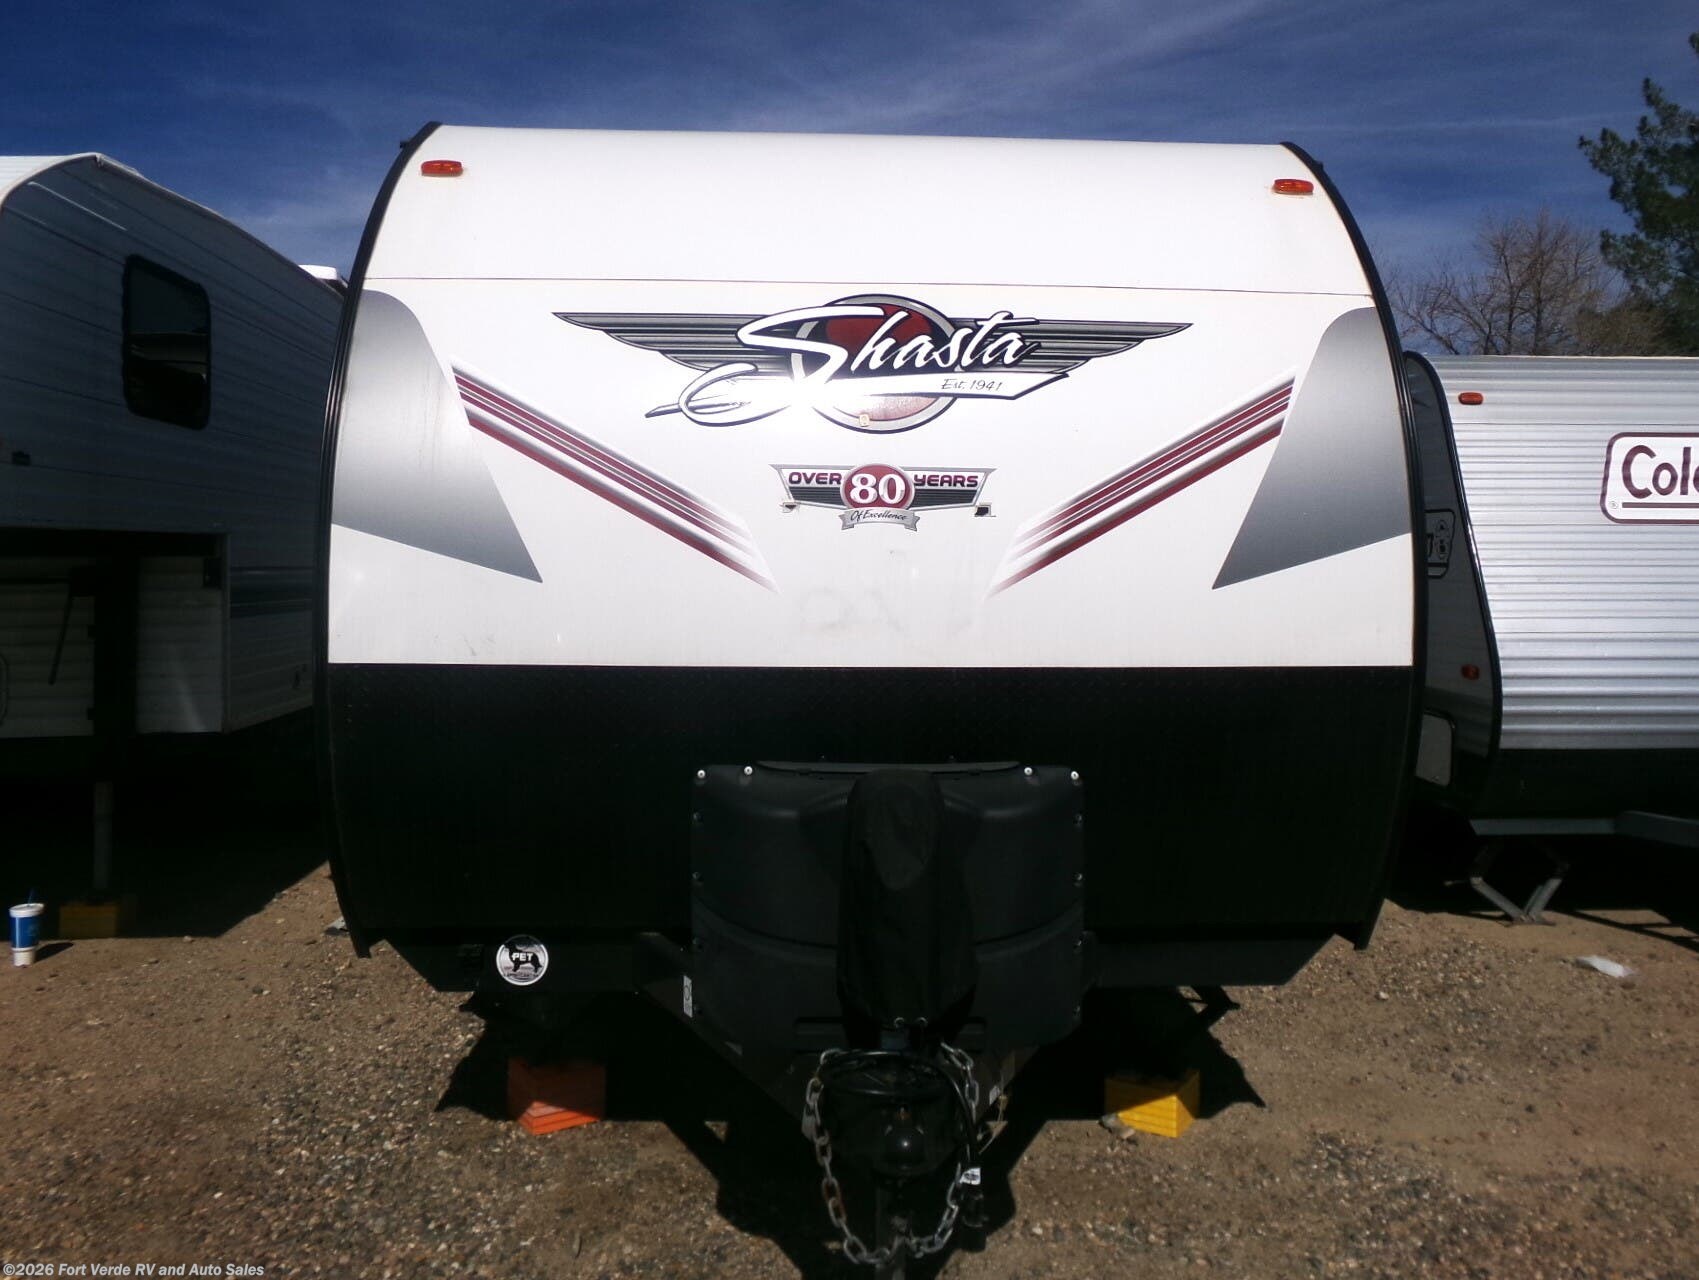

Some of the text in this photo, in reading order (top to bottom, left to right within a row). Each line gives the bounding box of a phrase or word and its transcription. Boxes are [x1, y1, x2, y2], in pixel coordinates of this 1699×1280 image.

[735, 306, 1040, 388] Shasta
[970, 379, 1003, 392] 1941
[788, 472, 979, 504] OVER 80 YEARS
[863, 509, 908, 521] Excellence
[511, 952, 533, 961] PET
